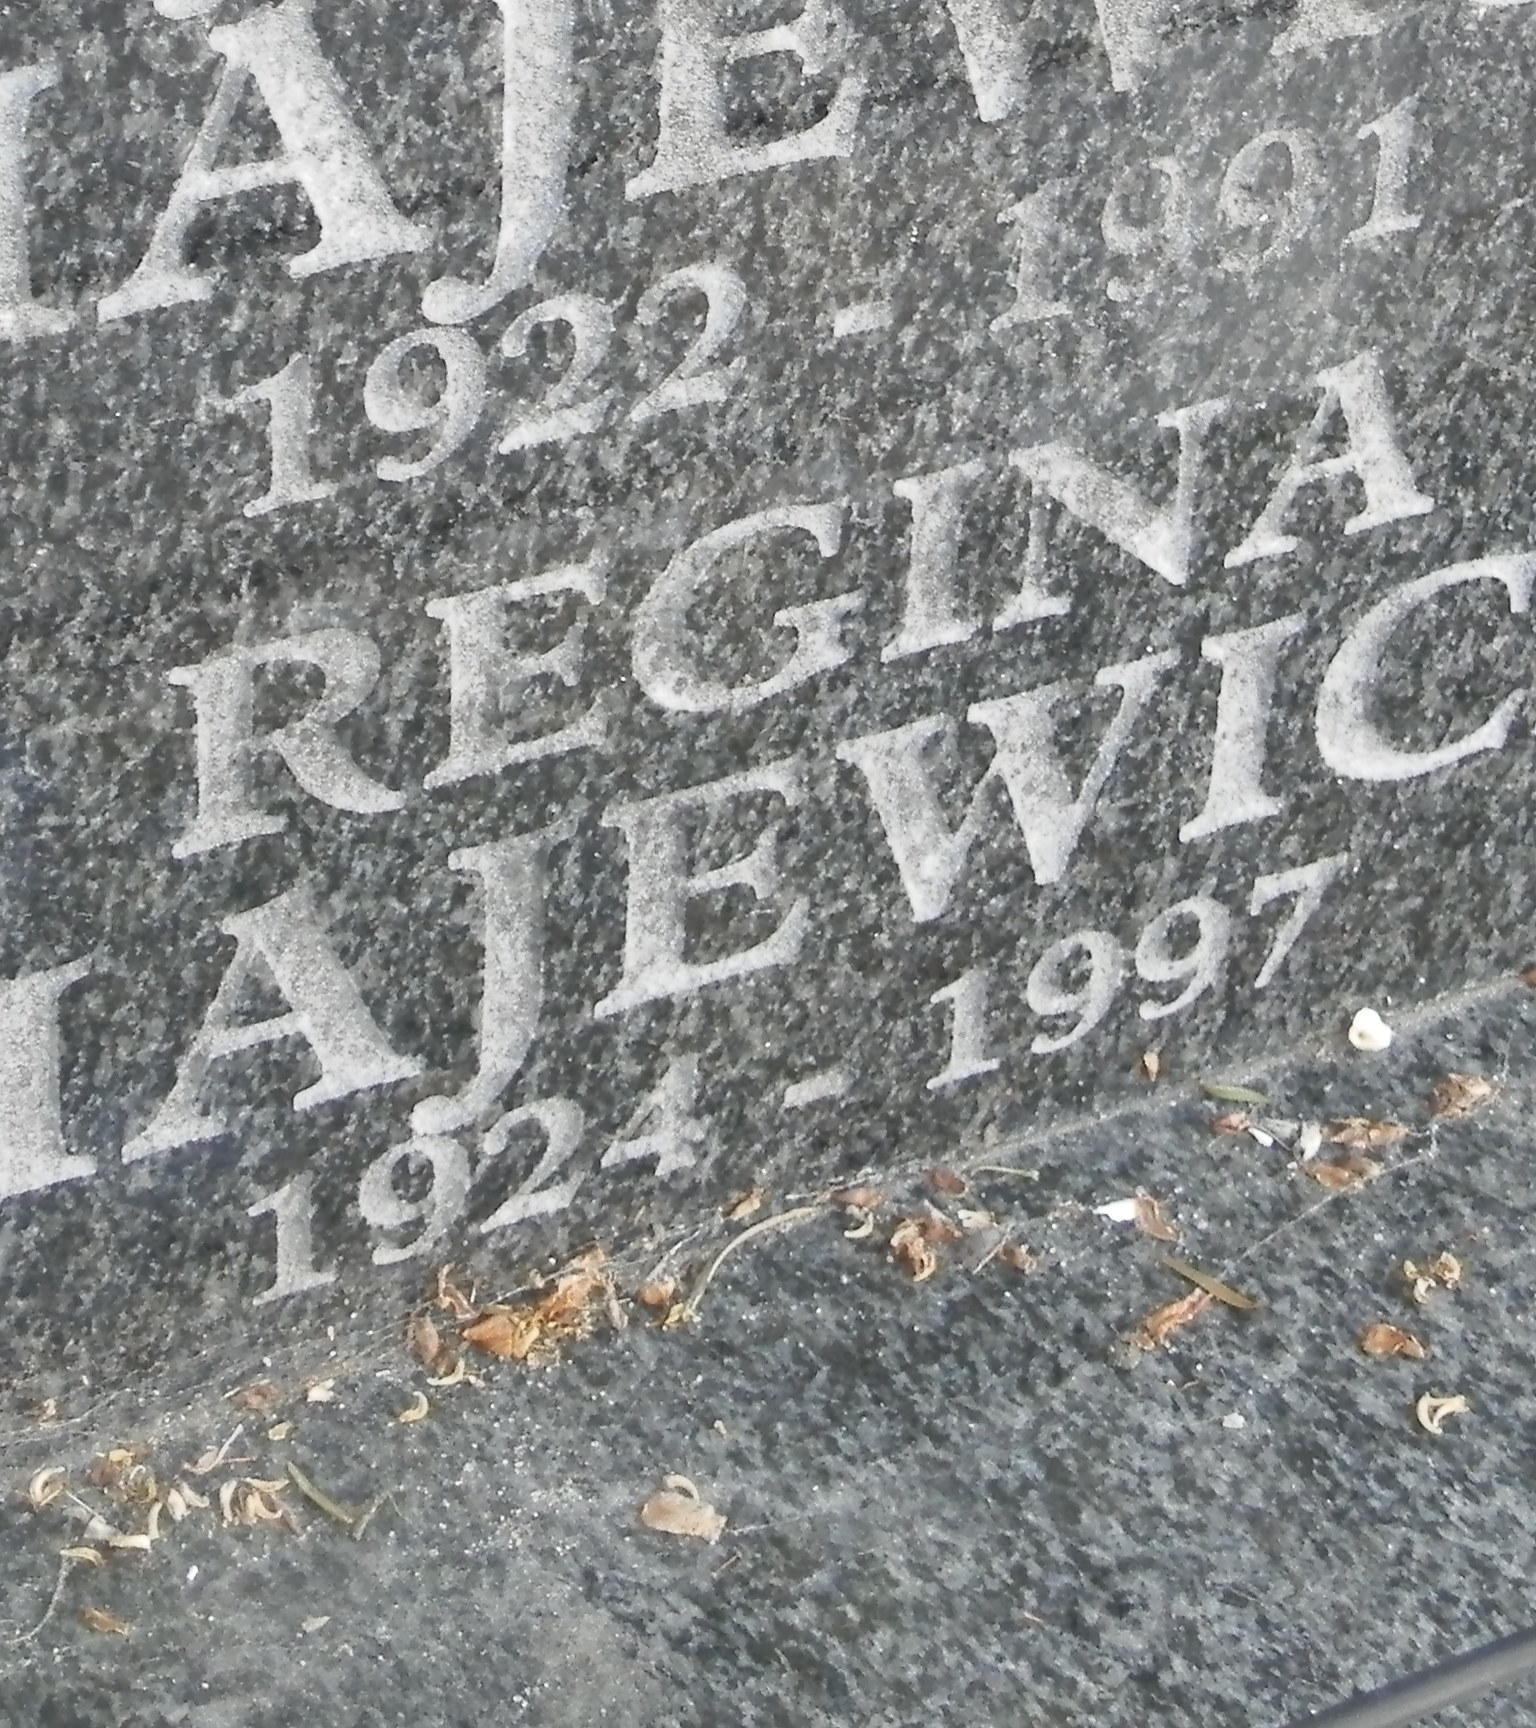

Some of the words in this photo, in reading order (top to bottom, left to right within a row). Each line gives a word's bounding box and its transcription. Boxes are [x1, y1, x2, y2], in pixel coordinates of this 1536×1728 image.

[235, 264, 748, 520] 1922
[832, 302, 894, 337] -
[996, 103, 1421, 327] 1991
[170, 361, 1434, 859] REGINA
[249, 1057, 710, 1298] 1924
[783, 1070, 846, 1103] -
[928, 860, 1343, 1089] 1997
